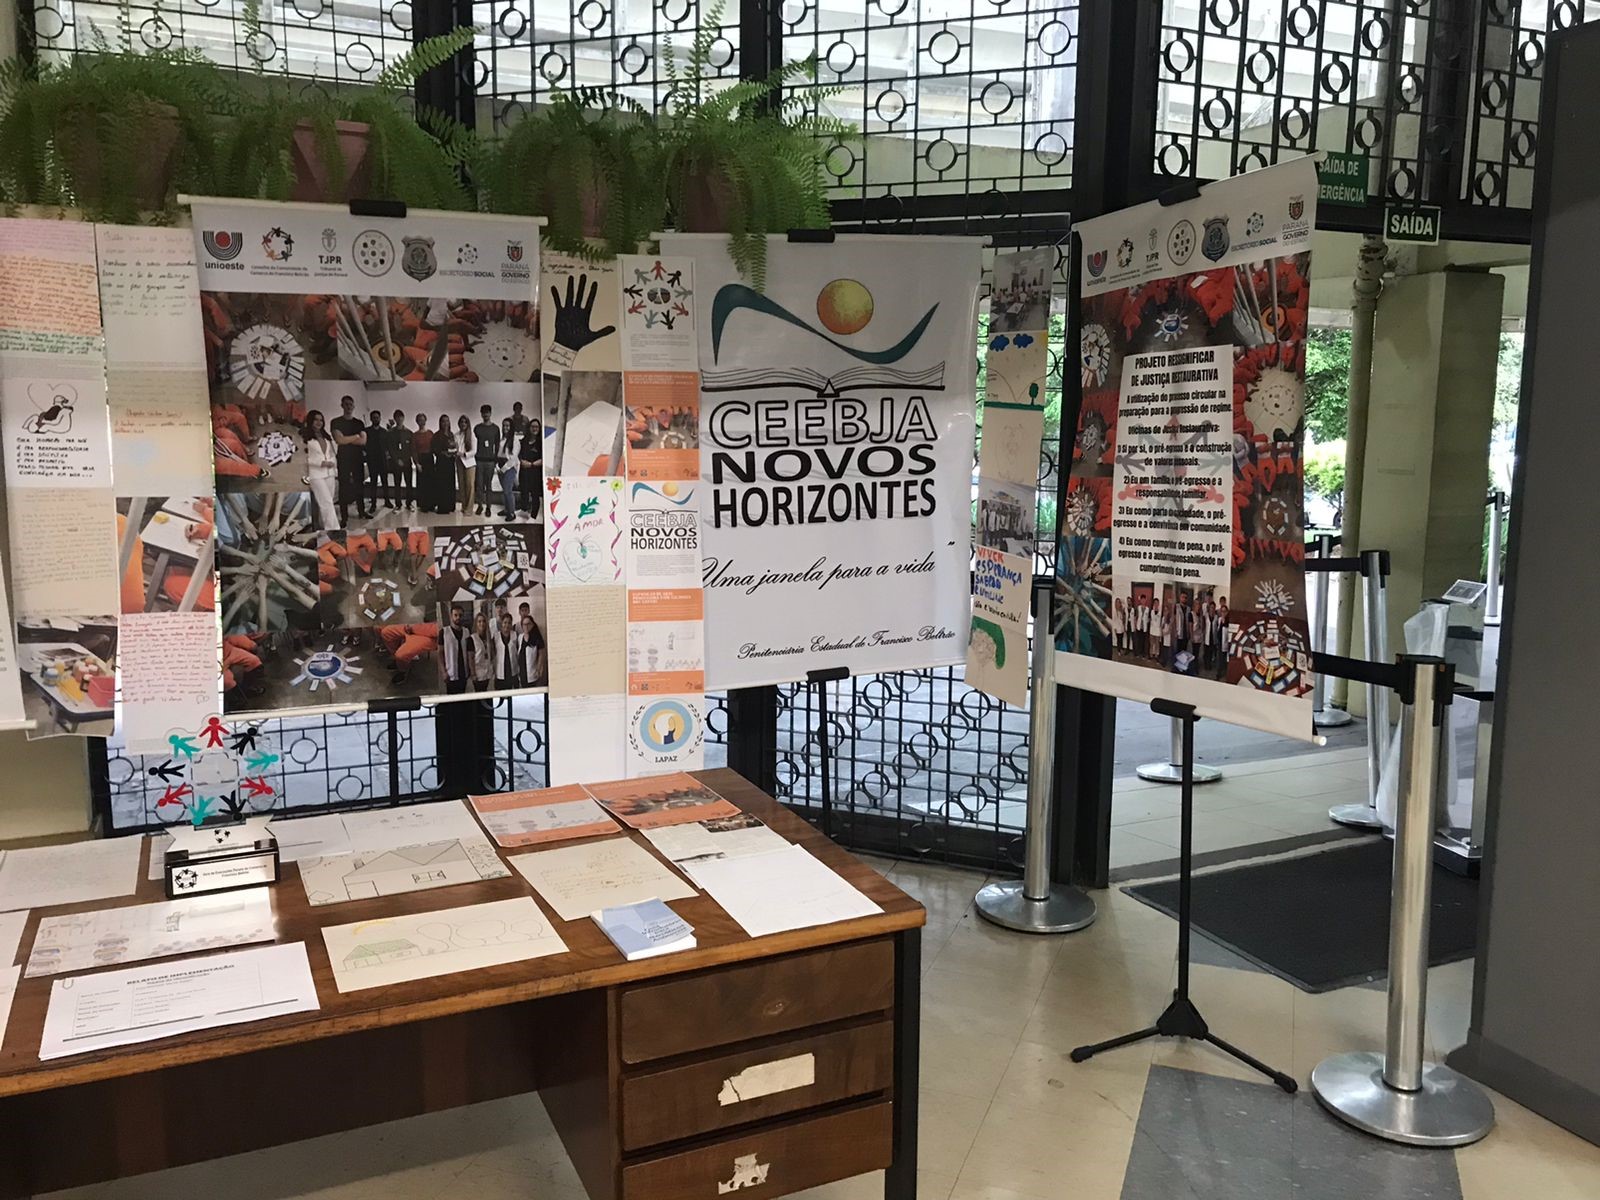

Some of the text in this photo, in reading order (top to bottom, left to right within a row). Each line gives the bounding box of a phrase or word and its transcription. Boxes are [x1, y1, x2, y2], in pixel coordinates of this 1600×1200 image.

[1319, 155, 1359, 176] SAÍDA DE
[1318, 183, 1365, 203] ERGÊNCIA
[1390, 211, 1433, 236] SAÍDA
[1260, 237, 1278, 247] SOCIAL
[1282, 229, 1309, 241] GOVERNO
[318, 255, 342, 265] TJPR
[1145, 252, 1160, 263] TJPR
[204, 260, 245, 271] unioeste
[474, 271, 495, 279] SOCIAL
[1135, 350, 1215, 369] PROJETO RESSIGNIFICAR
[1131, 368, 1218, 388] DE JUSTIÇA RESTAURATIVA
[1127, 395, 1130, 404] A
[1131, 392, 1159, 405] utilização
[1160, 393, 1168, 402] do
[1191, 389, 1217, 400] circular
[1219, 390, 1226, 398] na
[1119, 406, 1149, 418] preparação
[1150, 406, 1165, 417] para
[1166, 406, 1169, 414] a
[1200, 403, 1209, 412] de
[1210, 403, 1232, 413] regime.
[709, 396, 939, 449] CEEBJA
[1128, 426, 1152, 435] Oficinas
[1153, 425, 1161, 434] de
[1128, 446, 1138, 454] por
[1195, 441, 1232, 455] construção
[711, 443, 937, 484] NOVOS
[1144, 457, 1153, 466] de
[1123, 475, 1130, 484] 2)
[1130, 475, 1138, 484] Eu
[1139, 476, 1150, 484] em
[1211, 477, 1216, 486] e
[1217, 477, 1222, 486] a
[1181, 489, 1209, 499] familiar.
[713, 478, 936, 529] HORIZONTES
[1118, 506, 1125, 515] 3)
[1126, 506, 1133, 515] Eu
[1134, 507, 1151, 516] como
[1207, 511, 1211, 519] o
[1212, 509, 1226, 520] pré-
[574, 519, 603, 531] AMOR
[630, 513, 698, 528] CEEBJA
[1113, 519, 1137, 528] egresso
[1138, 520, 1142, 528] e
[1143, 520, 1148, 528] a
[1179, 522, 1190, 531] em
[1190, 523, 1232, 533] comunidade.
[630, 527, 697, 537] NOVOS
[630, 537, 698, 550] HORIZONTES
[1119, 537, 1125, 545] 4)
[1126, 537, 1133, 546] Eu
[1134, 538, 1151, 547] como
[1178, 541, 1186, 550] de
[1186, 542, 1205, 552] pena,
[1205, 543, 1211, 551] o
[1211, 542, 1225, 554] pré-
[1118, 550, 1142, 559] egresso
[1142, 551, 1147, 559] e
[1148, 551, 1152, 559] a
[1217, 558, 1225, 567] no
[701, 557, 754, 588] Uma
[745, 556, 827, 595] janela
[818, 562, 873, 590] para
[876, 564, 889, 576] a
[894, 550, 935, 574] vida
[1175, 566, 1182, 576] da
[1183, 568, 1201, 578] pena.
[737, 625, 956, 660] Penitenciária Estadual de Francisco Beltrão
[126, 976, 157, 985] RELATO
[169, 964, 235, 978] IMPLEMENTAÇÃO
